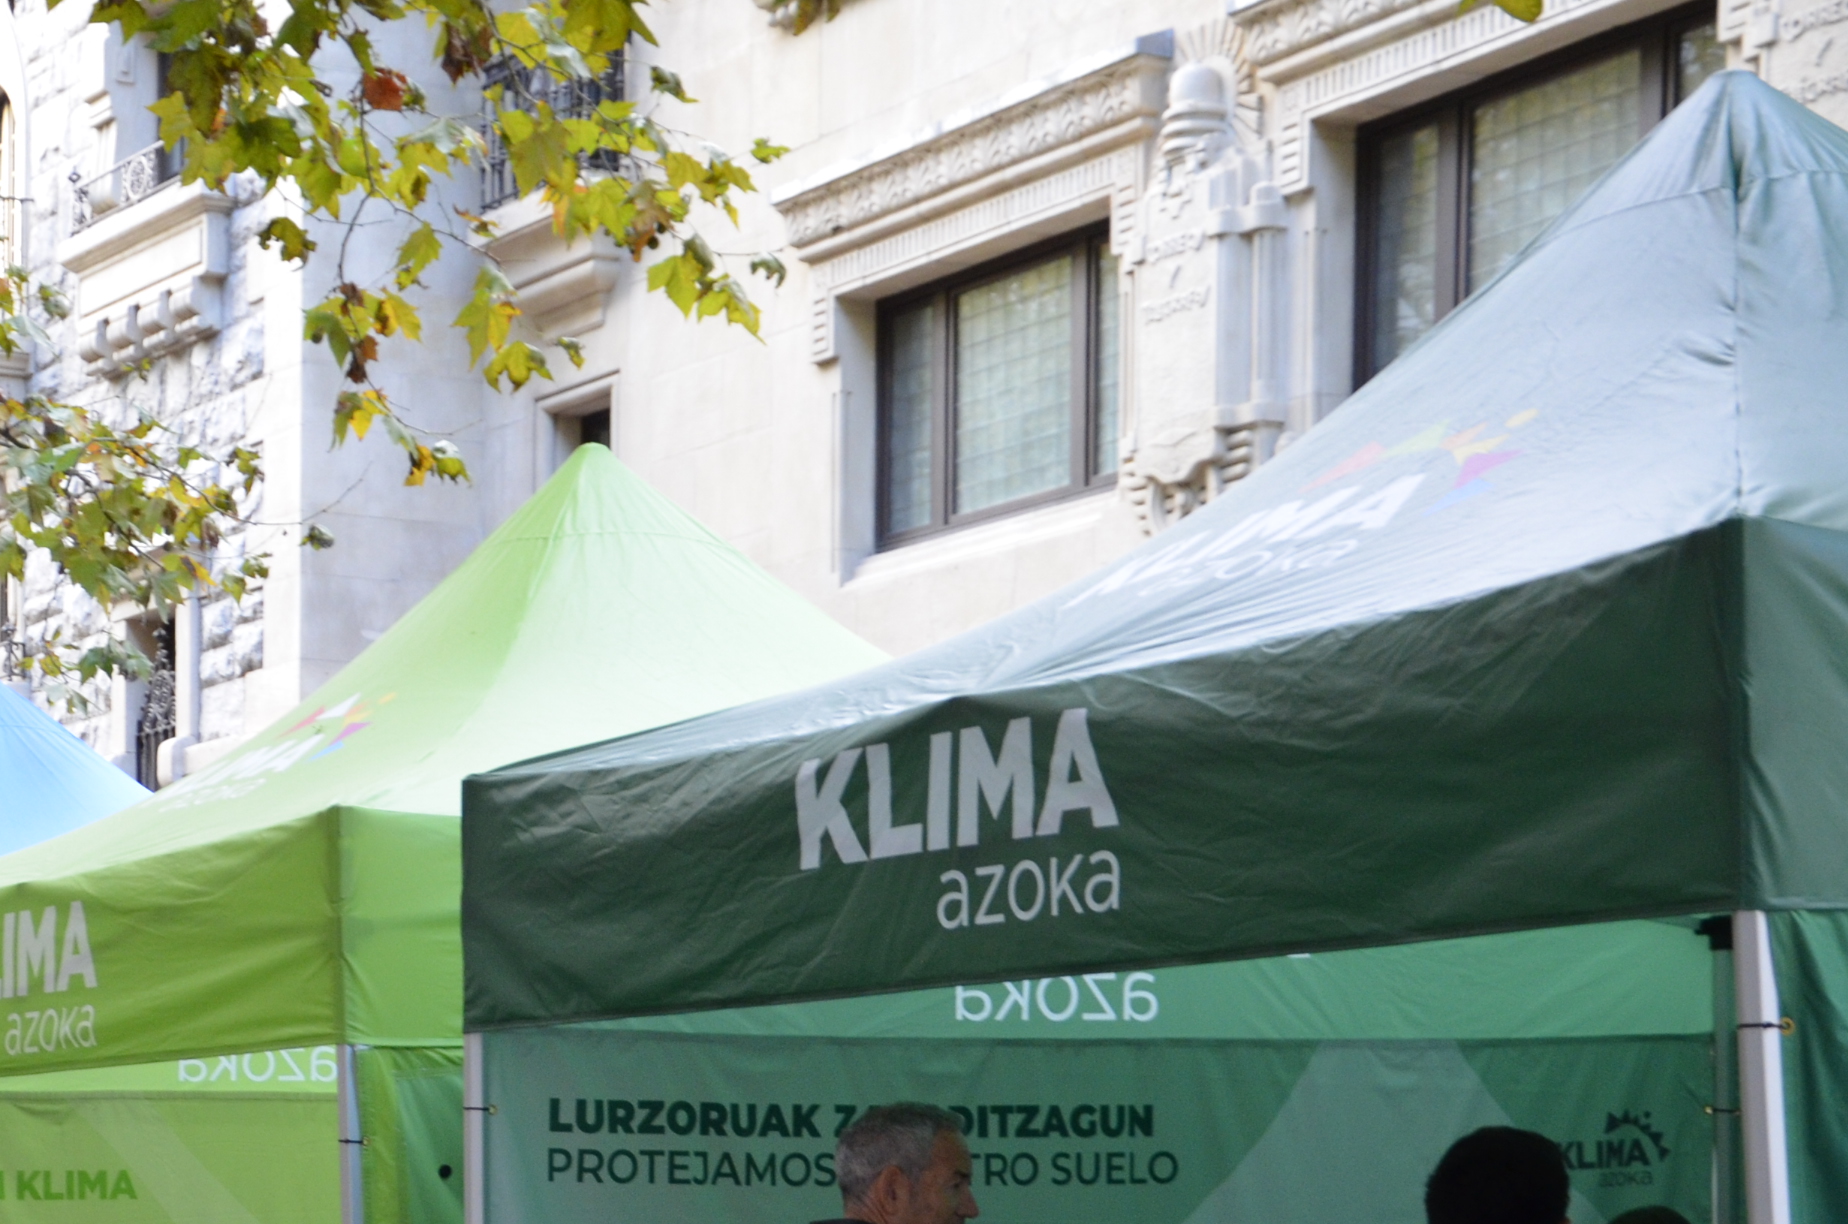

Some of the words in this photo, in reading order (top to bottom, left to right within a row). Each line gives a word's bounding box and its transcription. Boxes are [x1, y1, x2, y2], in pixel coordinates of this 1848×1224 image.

[792, 707, 1119, 871] KLIMA
[936, 850, 1121, 929] azoka
[4, 1004, 97, 1056] azoka
[548, 1097, 821, 1138] LURZORUAK
[833, 1102, 1155, 1138] ZDITZAGUN
[15, 1169, 139, 1201] KLIMA
[547, 1147, 839, 1187] PROTEJAMOS
[1051, 1151, 1180, 1186] SUELO
